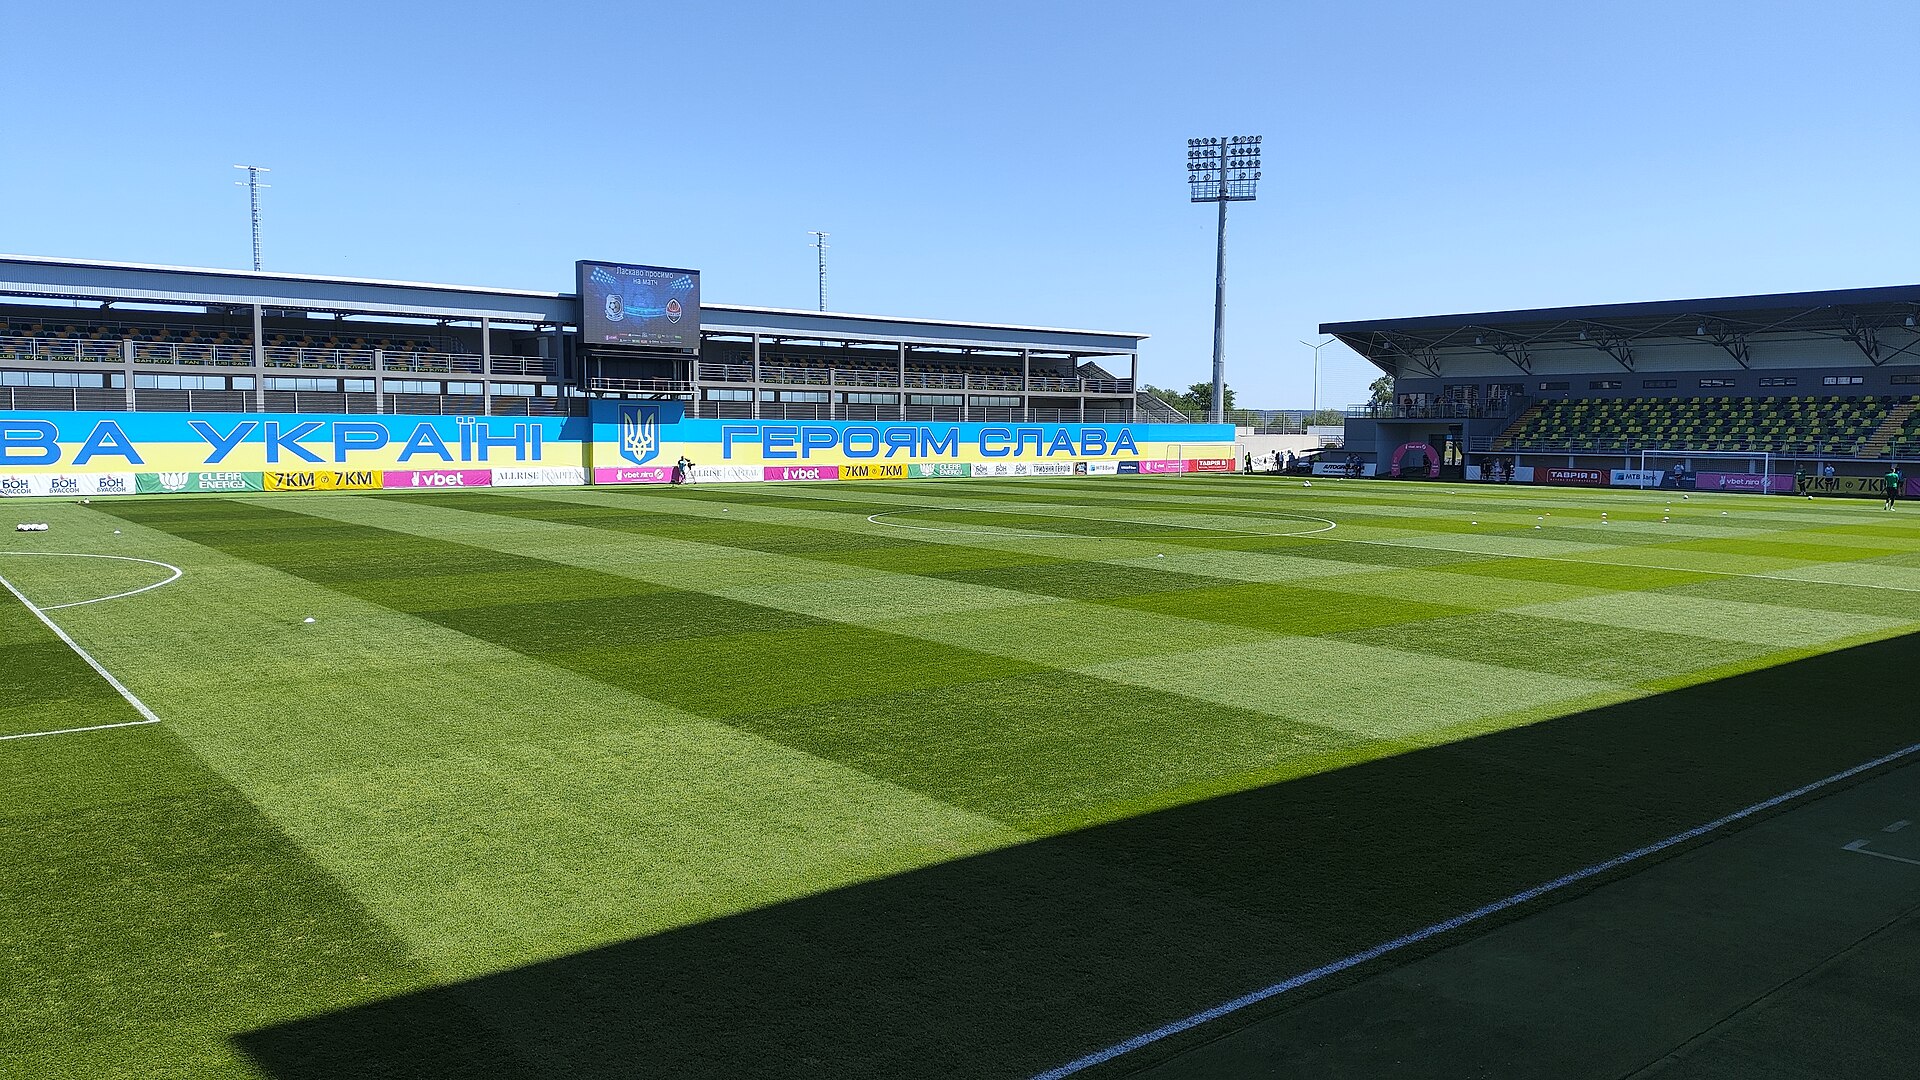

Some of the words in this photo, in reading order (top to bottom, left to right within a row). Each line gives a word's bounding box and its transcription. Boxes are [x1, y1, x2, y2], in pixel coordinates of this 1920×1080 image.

[616, 267, 644, 277] Ласкаво
[645, 271, 674, 279] просимо
[0, 419, 146, 466] ВА
[187, 416, 544, 465] УКРАЇНІ
[722, 425, 960, 461] ГЕРОЯМ
[979, 427, 1140, 457] СЛАВА
[198, 472, 242, 481] CLEAR
[498, 471, 540, 480] ALLRISE
[791, 467, 820, 479] vbet
[1550, 471, 1588, 479] ТАВРІЯ
[2, 479, 29, 489] БОН
[51, 478, 77, 488] БОН
[98, 477, 124, 487] БОН
[422, 472, 464, 486] vbet
[1726, 478, 1745, 486] vbet
[199, 480, 246, 490] ENERGY
